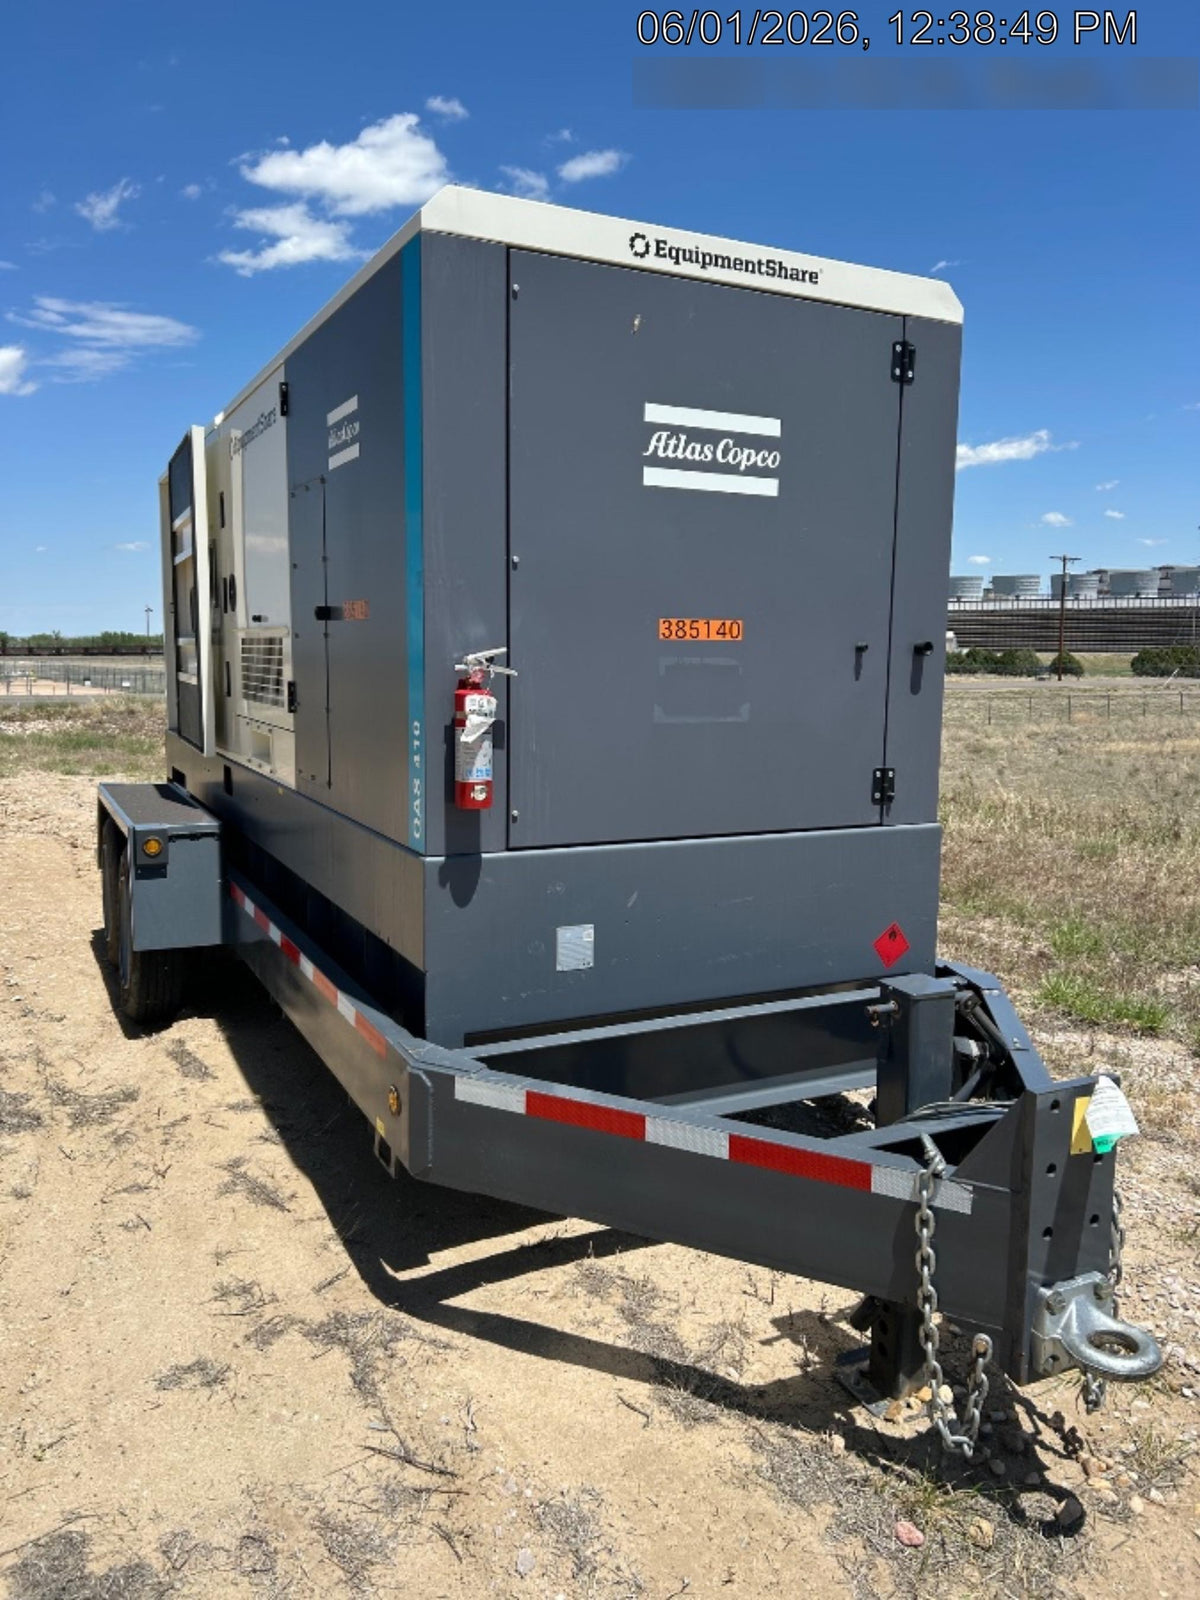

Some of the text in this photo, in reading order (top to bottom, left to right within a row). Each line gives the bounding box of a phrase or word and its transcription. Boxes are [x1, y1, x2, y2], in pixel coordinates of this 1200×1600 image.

[654, 238, 820, 285] EquipmentShare
[643, 431, 781, 471] Atlas Copco
[660, 619, 741, 639] 385140
[412, 720, 422, 769] 410
